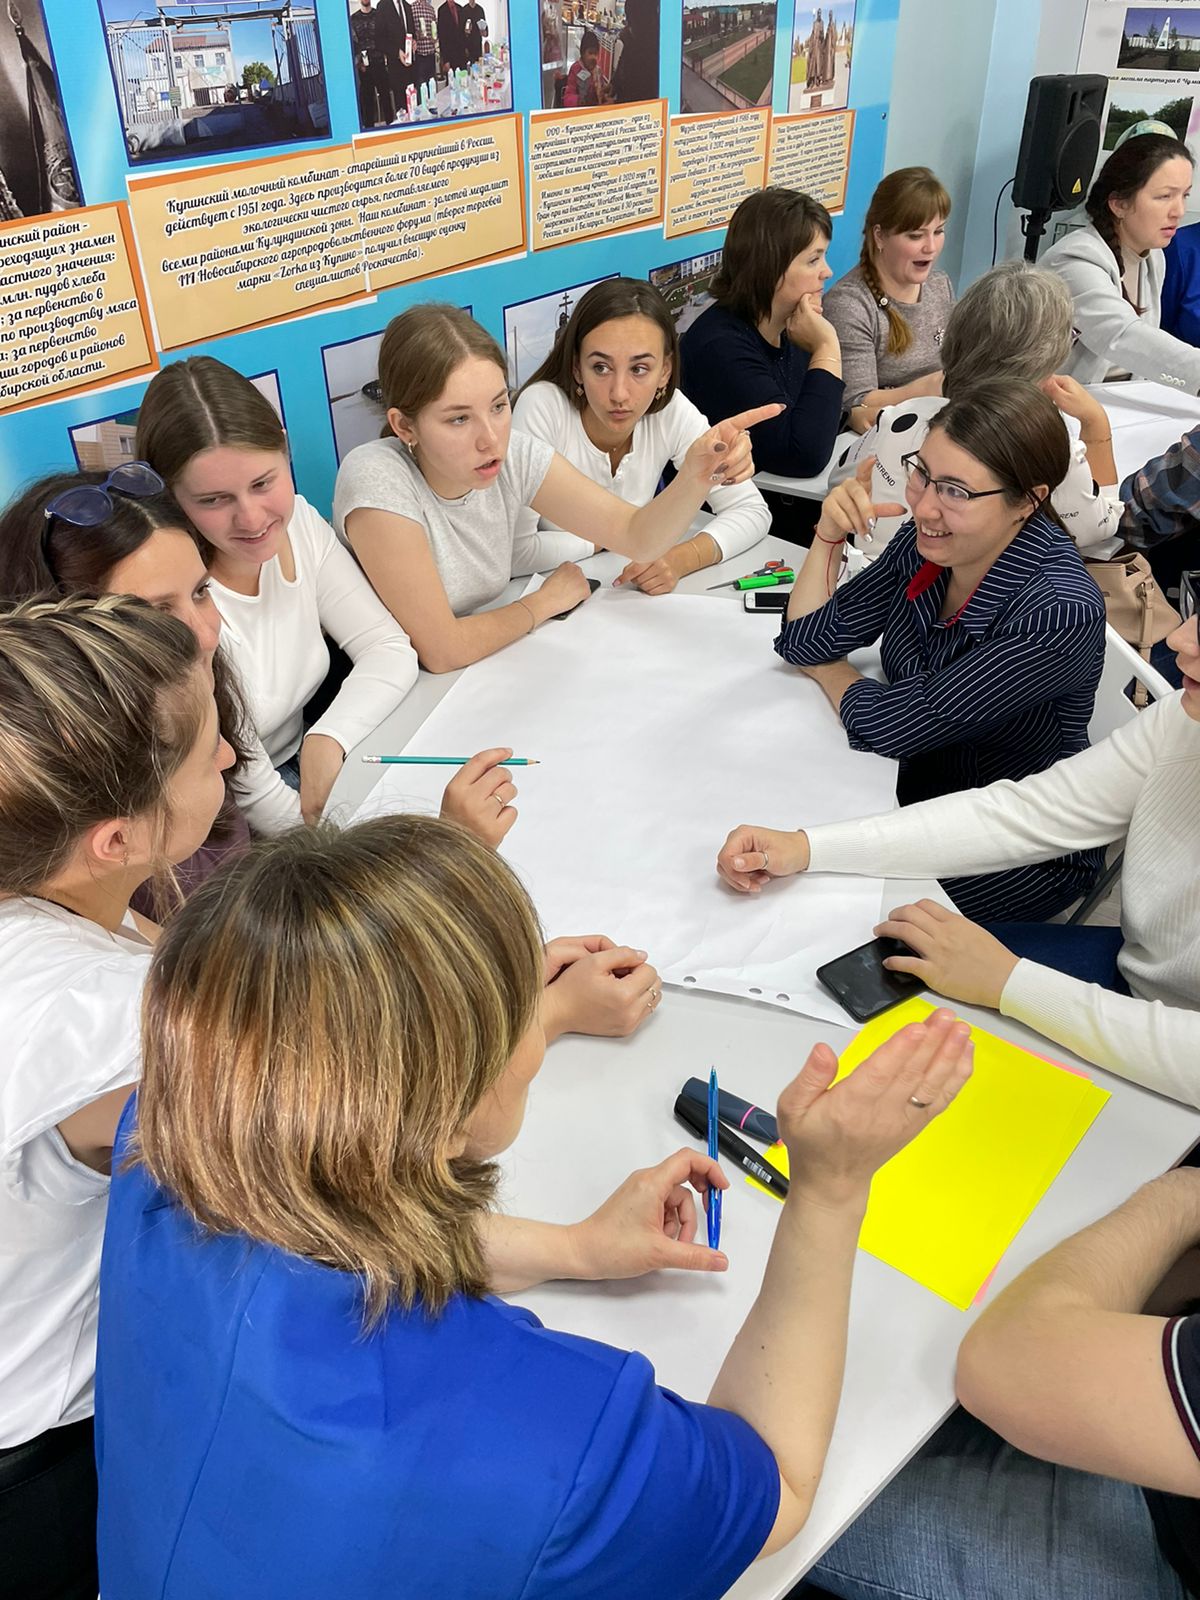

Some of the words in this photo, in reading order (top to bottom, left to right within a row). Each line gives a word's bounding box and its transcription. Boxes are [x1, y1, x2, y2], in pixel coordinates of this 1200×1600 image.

[164, 210, 229, 237] действует
[229, 209, 235, 219] с
[237, 201, 259, 217] 1951
[260, 198, 287, 213] года.
[288, 191, 315, 207] Здесь
[317, 176, 384, 201] производится
[384, 170, 408, 184] более
[409, 165, 421, 178] 70
[421, 159, 445, 176] видов
[446, 153, 489, 172] продукции
[489, 150, 500, 162] из
[165, 189, 230, 216] Купинский
[230, 177, 286, 200] молочный
[287, 168, 340, 188] комбинат
[346, 154, 400, 175] старейший
[400, 154, 407, 163] и
[407, 141, 460, 164] крупнейший
[460, 139, 465, 151] в
[161, 255, 199, 273] всеми
[199, 241, 255, 267] районами
[255, 221, 328, 251] Кулундинской
[330, 218, 354, 235] зоны.
[358, 210, 380, 223] Наш
[380, 199, 427, 218] комбинат
[433, 187, 468, 208] золотой
[468, 179, 509, 197] медалист
[243, 210, 310, 234] экологически
[310, 201, 349, 217] чистого
[382, 178, 449, 201] поставляемого
[42, 223, 81, 243] район
[69, 234, 116, 256] знамен
[196, 253, 279, 282] Новосибирского
[280, 223, 395, 262] агропродовольственного
[396, 214, 432, 233] форума
[34, 276, 70, 298] пудов
[71, 270, 106, 288] хлеба
[55, 252, 115, 277] значения:
[236, 273, 272, 290] марки
[309, 259, 321, 272] из
[364, 238, 402, 255] получил
[294, 262, 361, 292] специалистов
[0, 331, 16, 343] по
[18, 306, 103, 340] производству
[105, 299, 137, 315] мяса
[7, 310, 23, 326] за
[24, 290, 94, 319] первенство
[96, 287, 104, 300] в
[12, 346, 27, 362] за
[28, 325, 97, 354] первенство
[21, 350, 68, 374] городов
[70, 350, 78, 360] и
[79, 333, 125, 361] районов
[51, 360, 106, 383] области.
